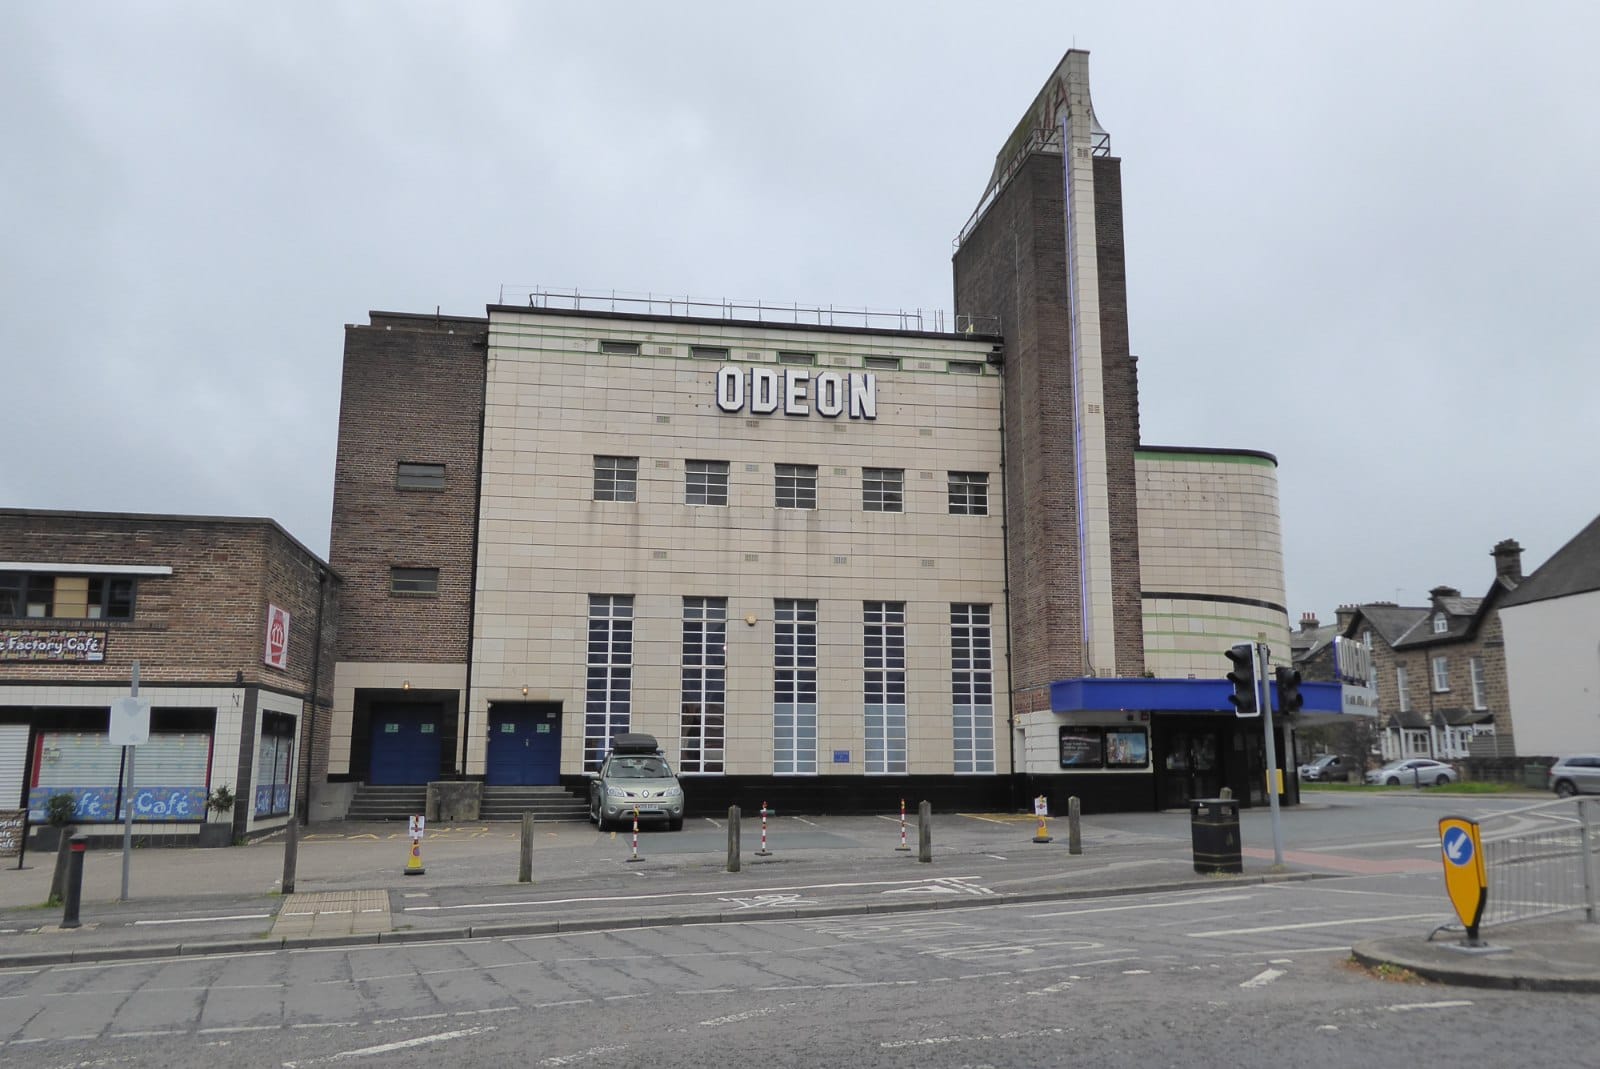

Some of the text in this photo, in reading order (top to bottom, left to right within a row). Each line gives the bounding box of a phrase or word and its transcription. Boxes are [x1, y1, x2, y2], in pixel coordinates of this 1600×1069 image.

[717, 366, 877, 420] ODEON
[8, 636, 62, 653] Factory
[67, 637, 98, 651] Café
[136, 792, 190, 815] Café
